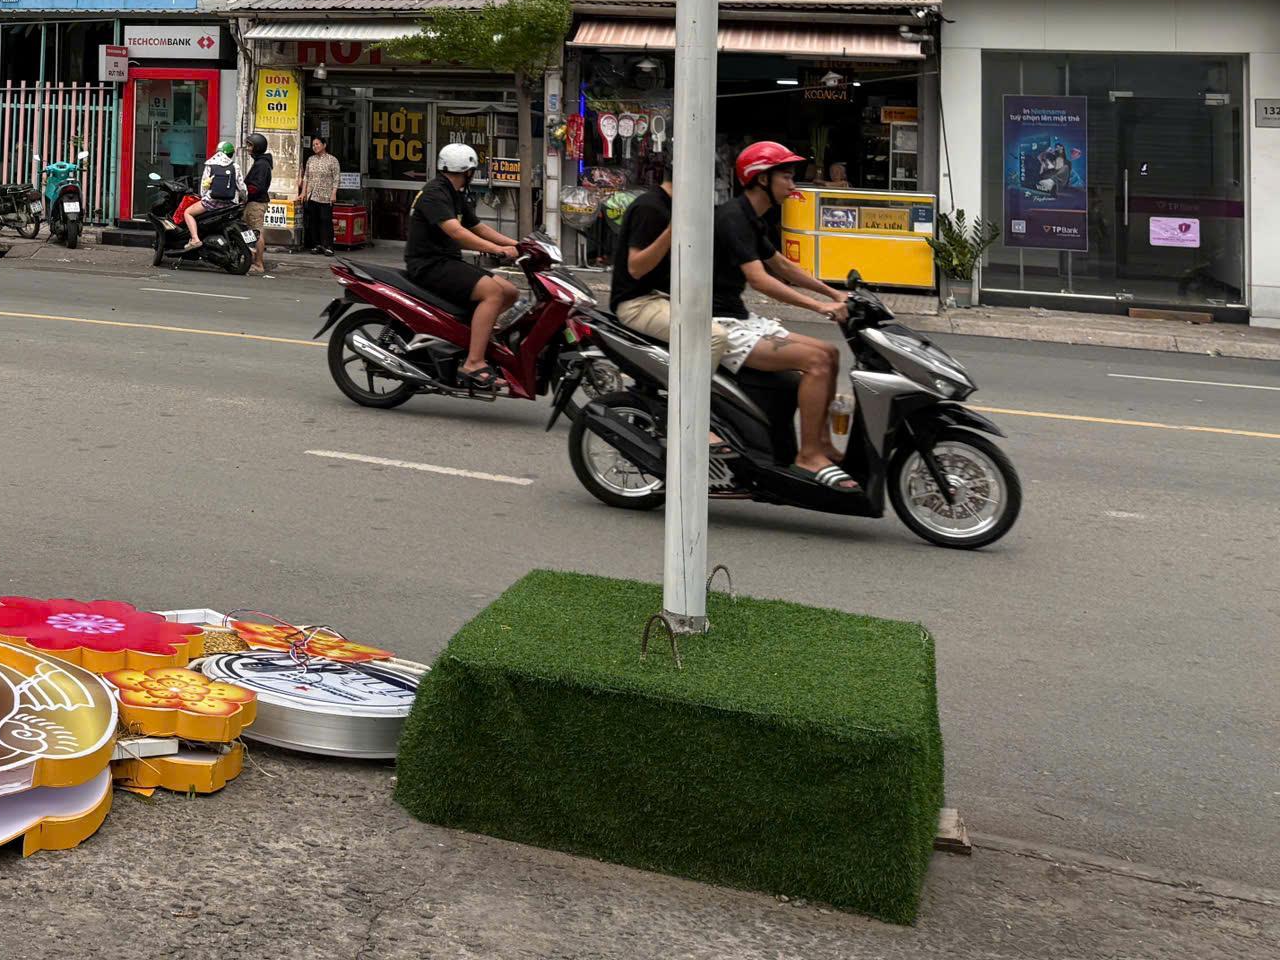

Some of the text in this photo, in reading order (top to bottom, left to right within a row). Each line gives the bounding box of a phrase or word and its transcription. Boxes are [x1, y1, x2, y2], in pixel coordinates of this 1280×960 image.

[127, 37, 191, 46] TECHCOMBANK
[373, 106, 423, 135] HỚT
[372, 135, 423, 162] TÓC
[1052, 226, 1079, 234] TPBank
